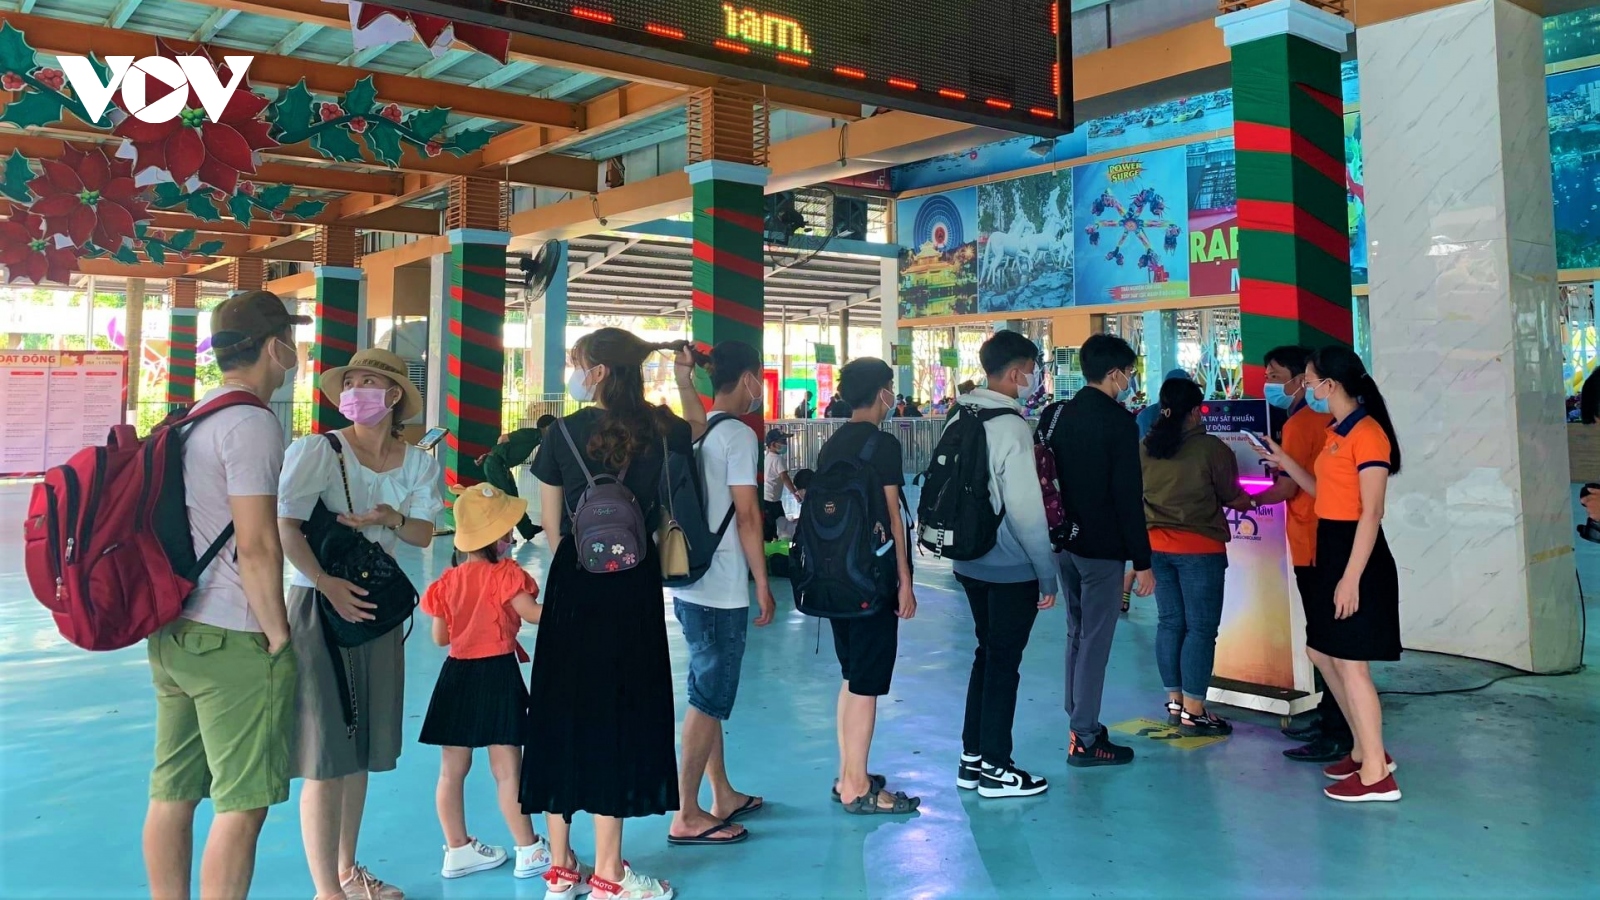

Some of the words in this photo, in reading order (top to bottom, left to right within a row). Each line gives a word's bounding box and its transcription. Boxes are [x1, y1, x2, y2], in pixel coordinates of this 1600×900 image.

[1108, 161, 1143, 173] POWER
[1111, 170, 1140, 182] SURGE
[22, 353, 56, 365] ĐỘNG
[1220, 414, 1231, 422] SÁT
[1212, 423, 1231, 432] ĐỘNG
